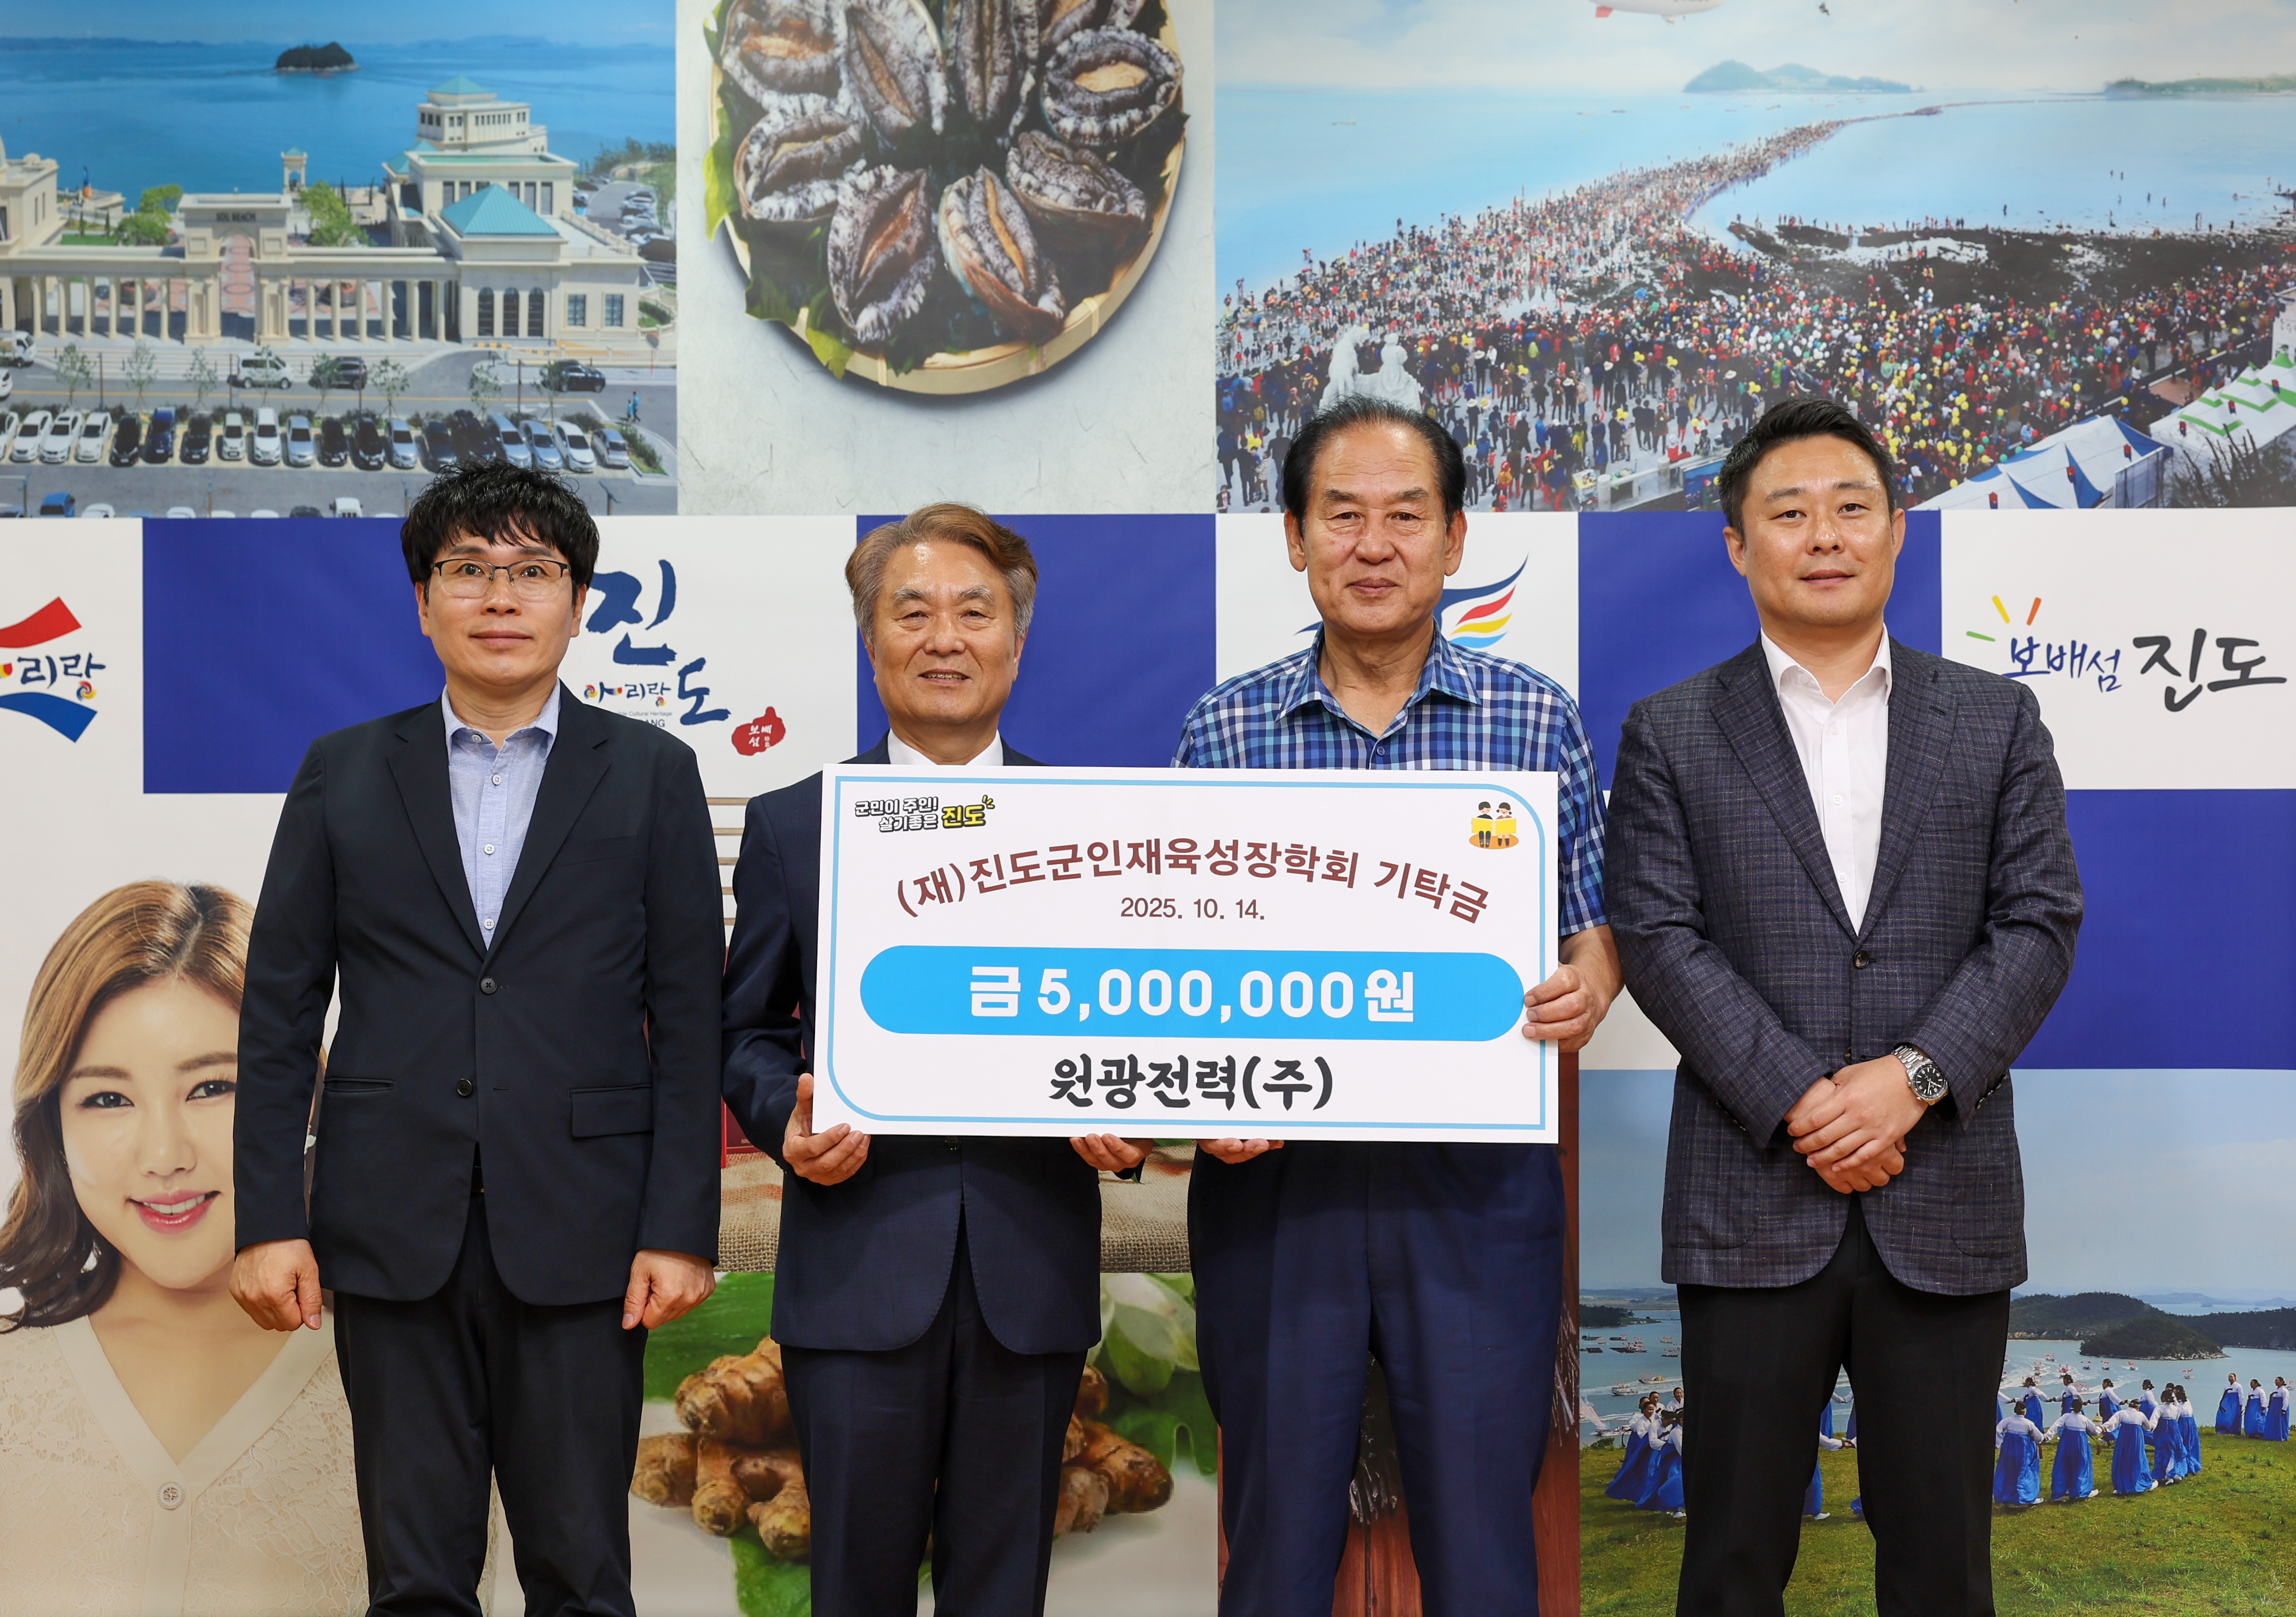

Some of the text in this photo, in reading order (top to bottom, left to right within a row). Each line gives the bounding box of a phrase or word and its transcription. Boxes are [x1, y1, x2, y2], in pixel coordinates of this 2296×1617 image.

[585, 560, 731, 725] 진도
[0, 652, 106, 701] 리랑
[584, 681, 672, 707] 아리랑
[2001, 628, 2287, 712] 보배섬 진도
[855, 796, 938, 817] 군민이 주인!
[878, 805, 986, 833] 살기좋은 진도
[1120, 897, 1265, 920] 2025. 10. 14.
[1373, 860, 1489, 924] 기탁금
[970, 966, 1022, 1017] 금
[1048, 1053, 1334, 1112] 원광전력(주)
